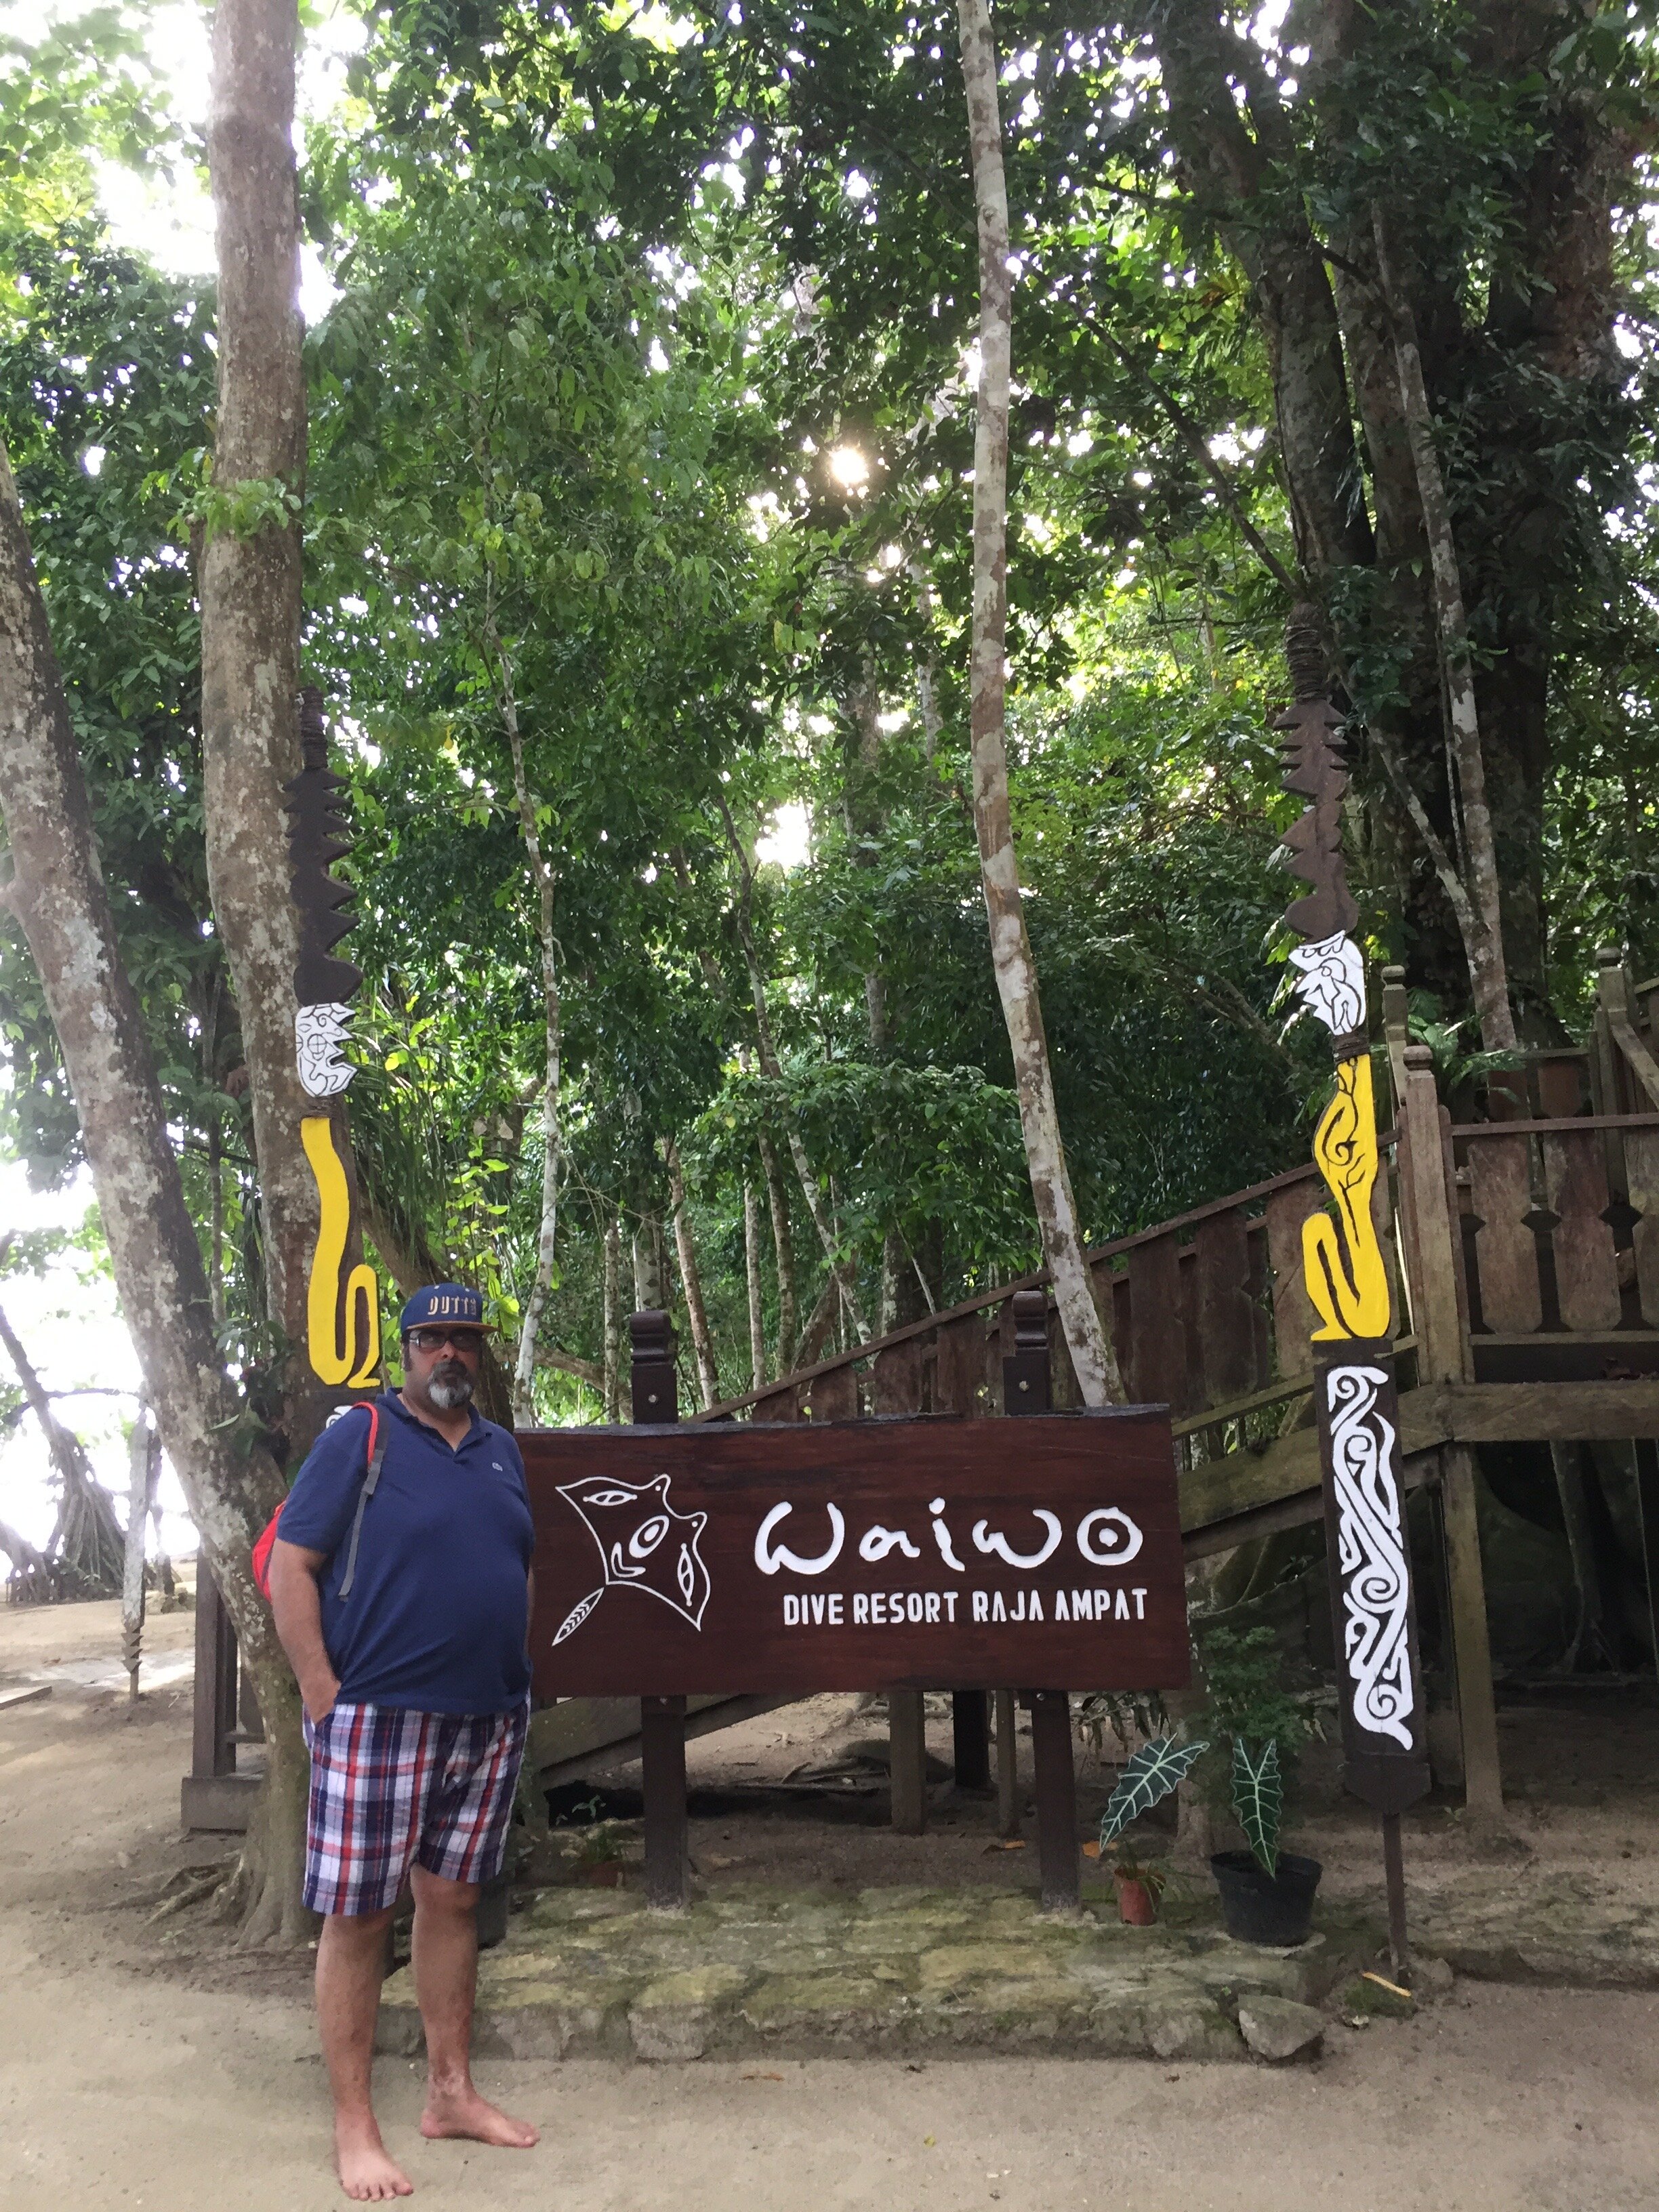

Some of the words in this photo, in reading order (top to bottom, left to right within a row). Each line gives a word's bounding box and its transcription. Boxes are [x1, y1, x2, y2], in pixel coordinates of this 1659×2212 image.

[754, 1497, 1143, 1575] Waiwo
[783, 1593, 844, 1626] DIVE
[853, 1591, 959, 1624] RESORT
[972, 1589, 1044, 1622] RAJA
[1054, 1588, 1147, 1621] AMPAT
